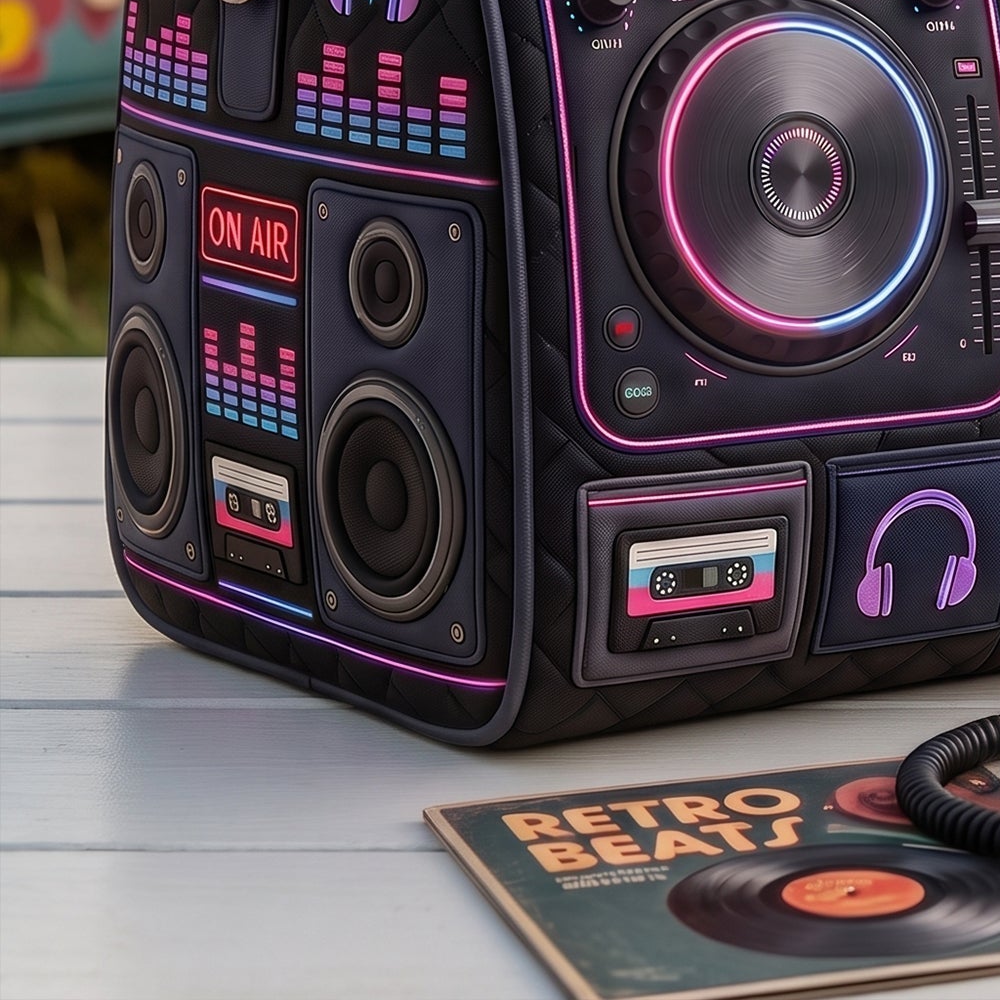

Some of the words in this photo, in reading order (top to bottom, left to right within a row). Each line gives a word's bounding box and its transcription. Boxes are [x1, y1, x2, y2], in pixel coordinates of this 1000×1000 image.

[209, 206, 242, 251] ON
[250, 216, 289, 264] AIR
[501, 787, 801, 842] RETRO
[527, 816, 804, 873] BEATS
